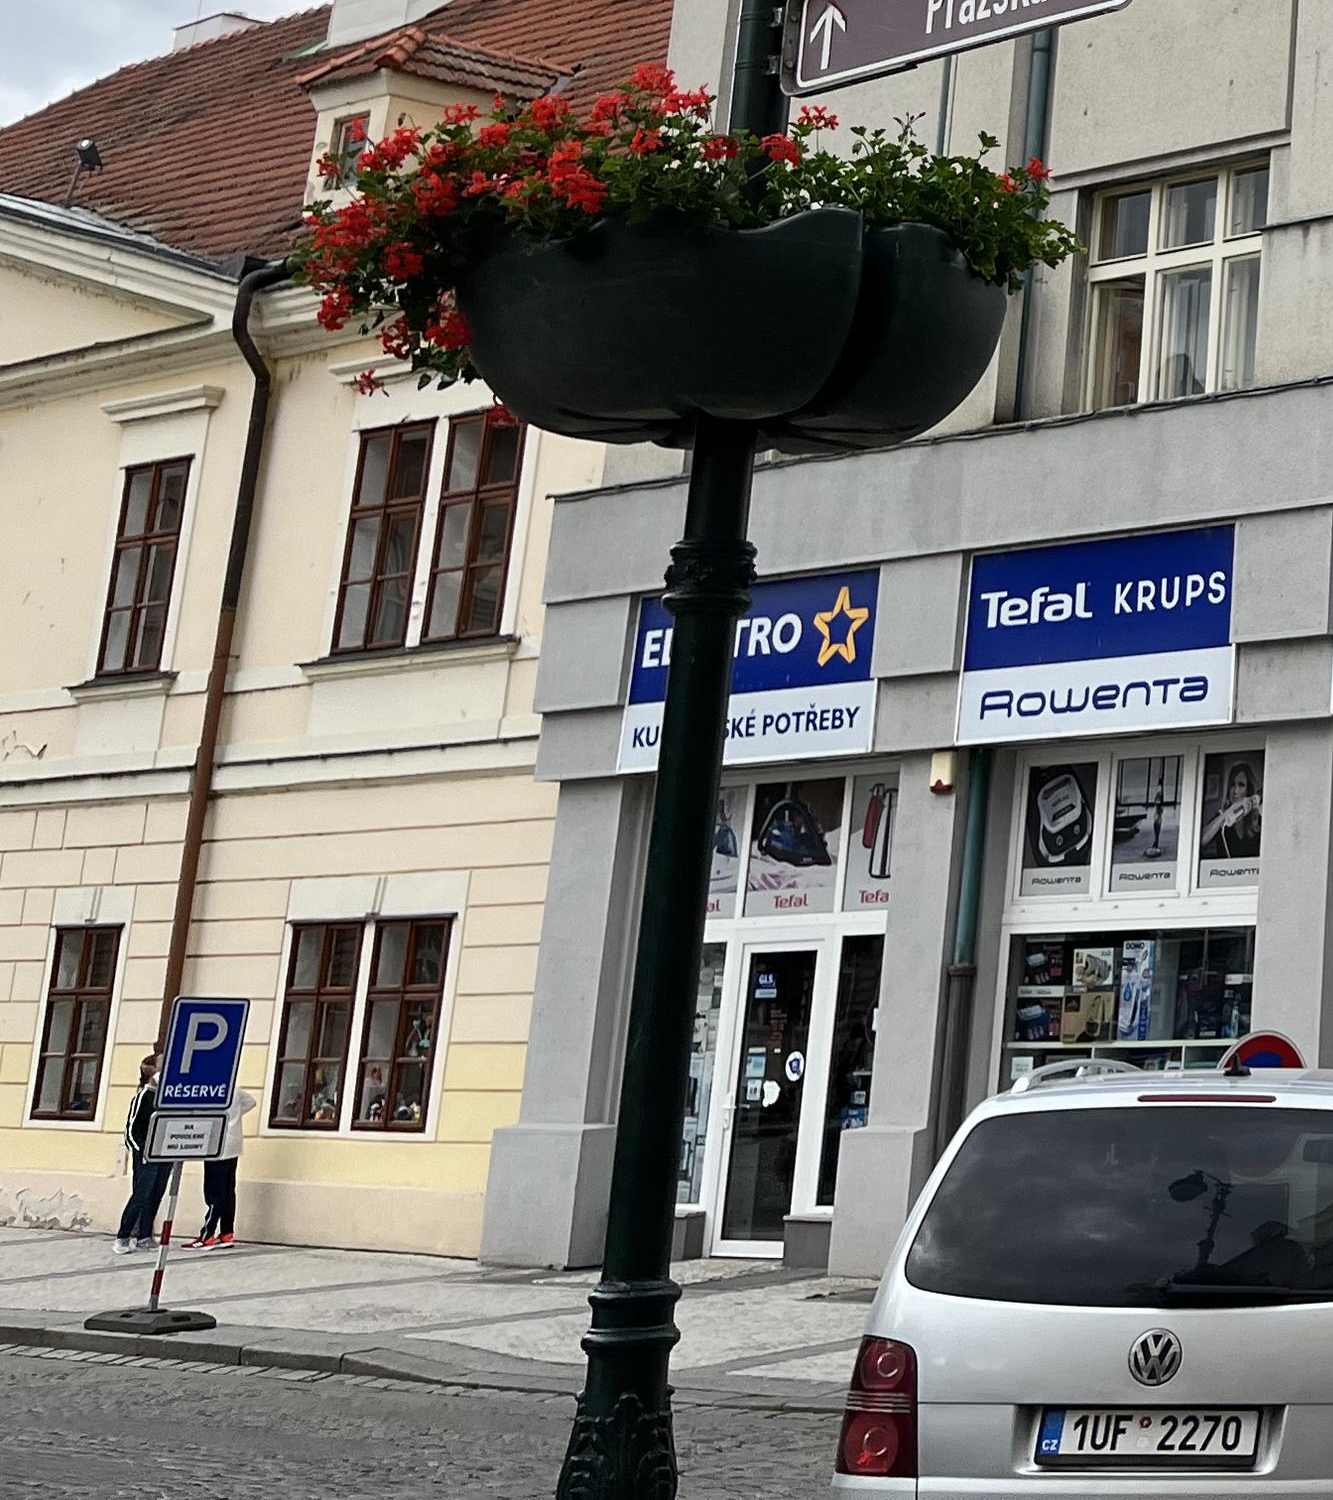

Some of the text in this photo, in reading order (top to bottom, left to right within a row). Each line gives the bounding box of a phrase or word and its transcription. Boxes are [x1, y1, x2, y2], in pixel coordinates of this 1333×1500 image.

[981, 571, 1226, 628] Tefal KRUPS
[763, 702, 861, 736] POTŘEBY
[774, 893, 808, 909] Tefal
[759, 973, 773, 984] GLS
[179, 1012, 228, 1074] P
[164, 1083, 226, 1098] RÉSERVÉ
[1042, 1439, 1058, 1451] CZ
[1073, 1414, 1242, 1451] 1UF 2270
